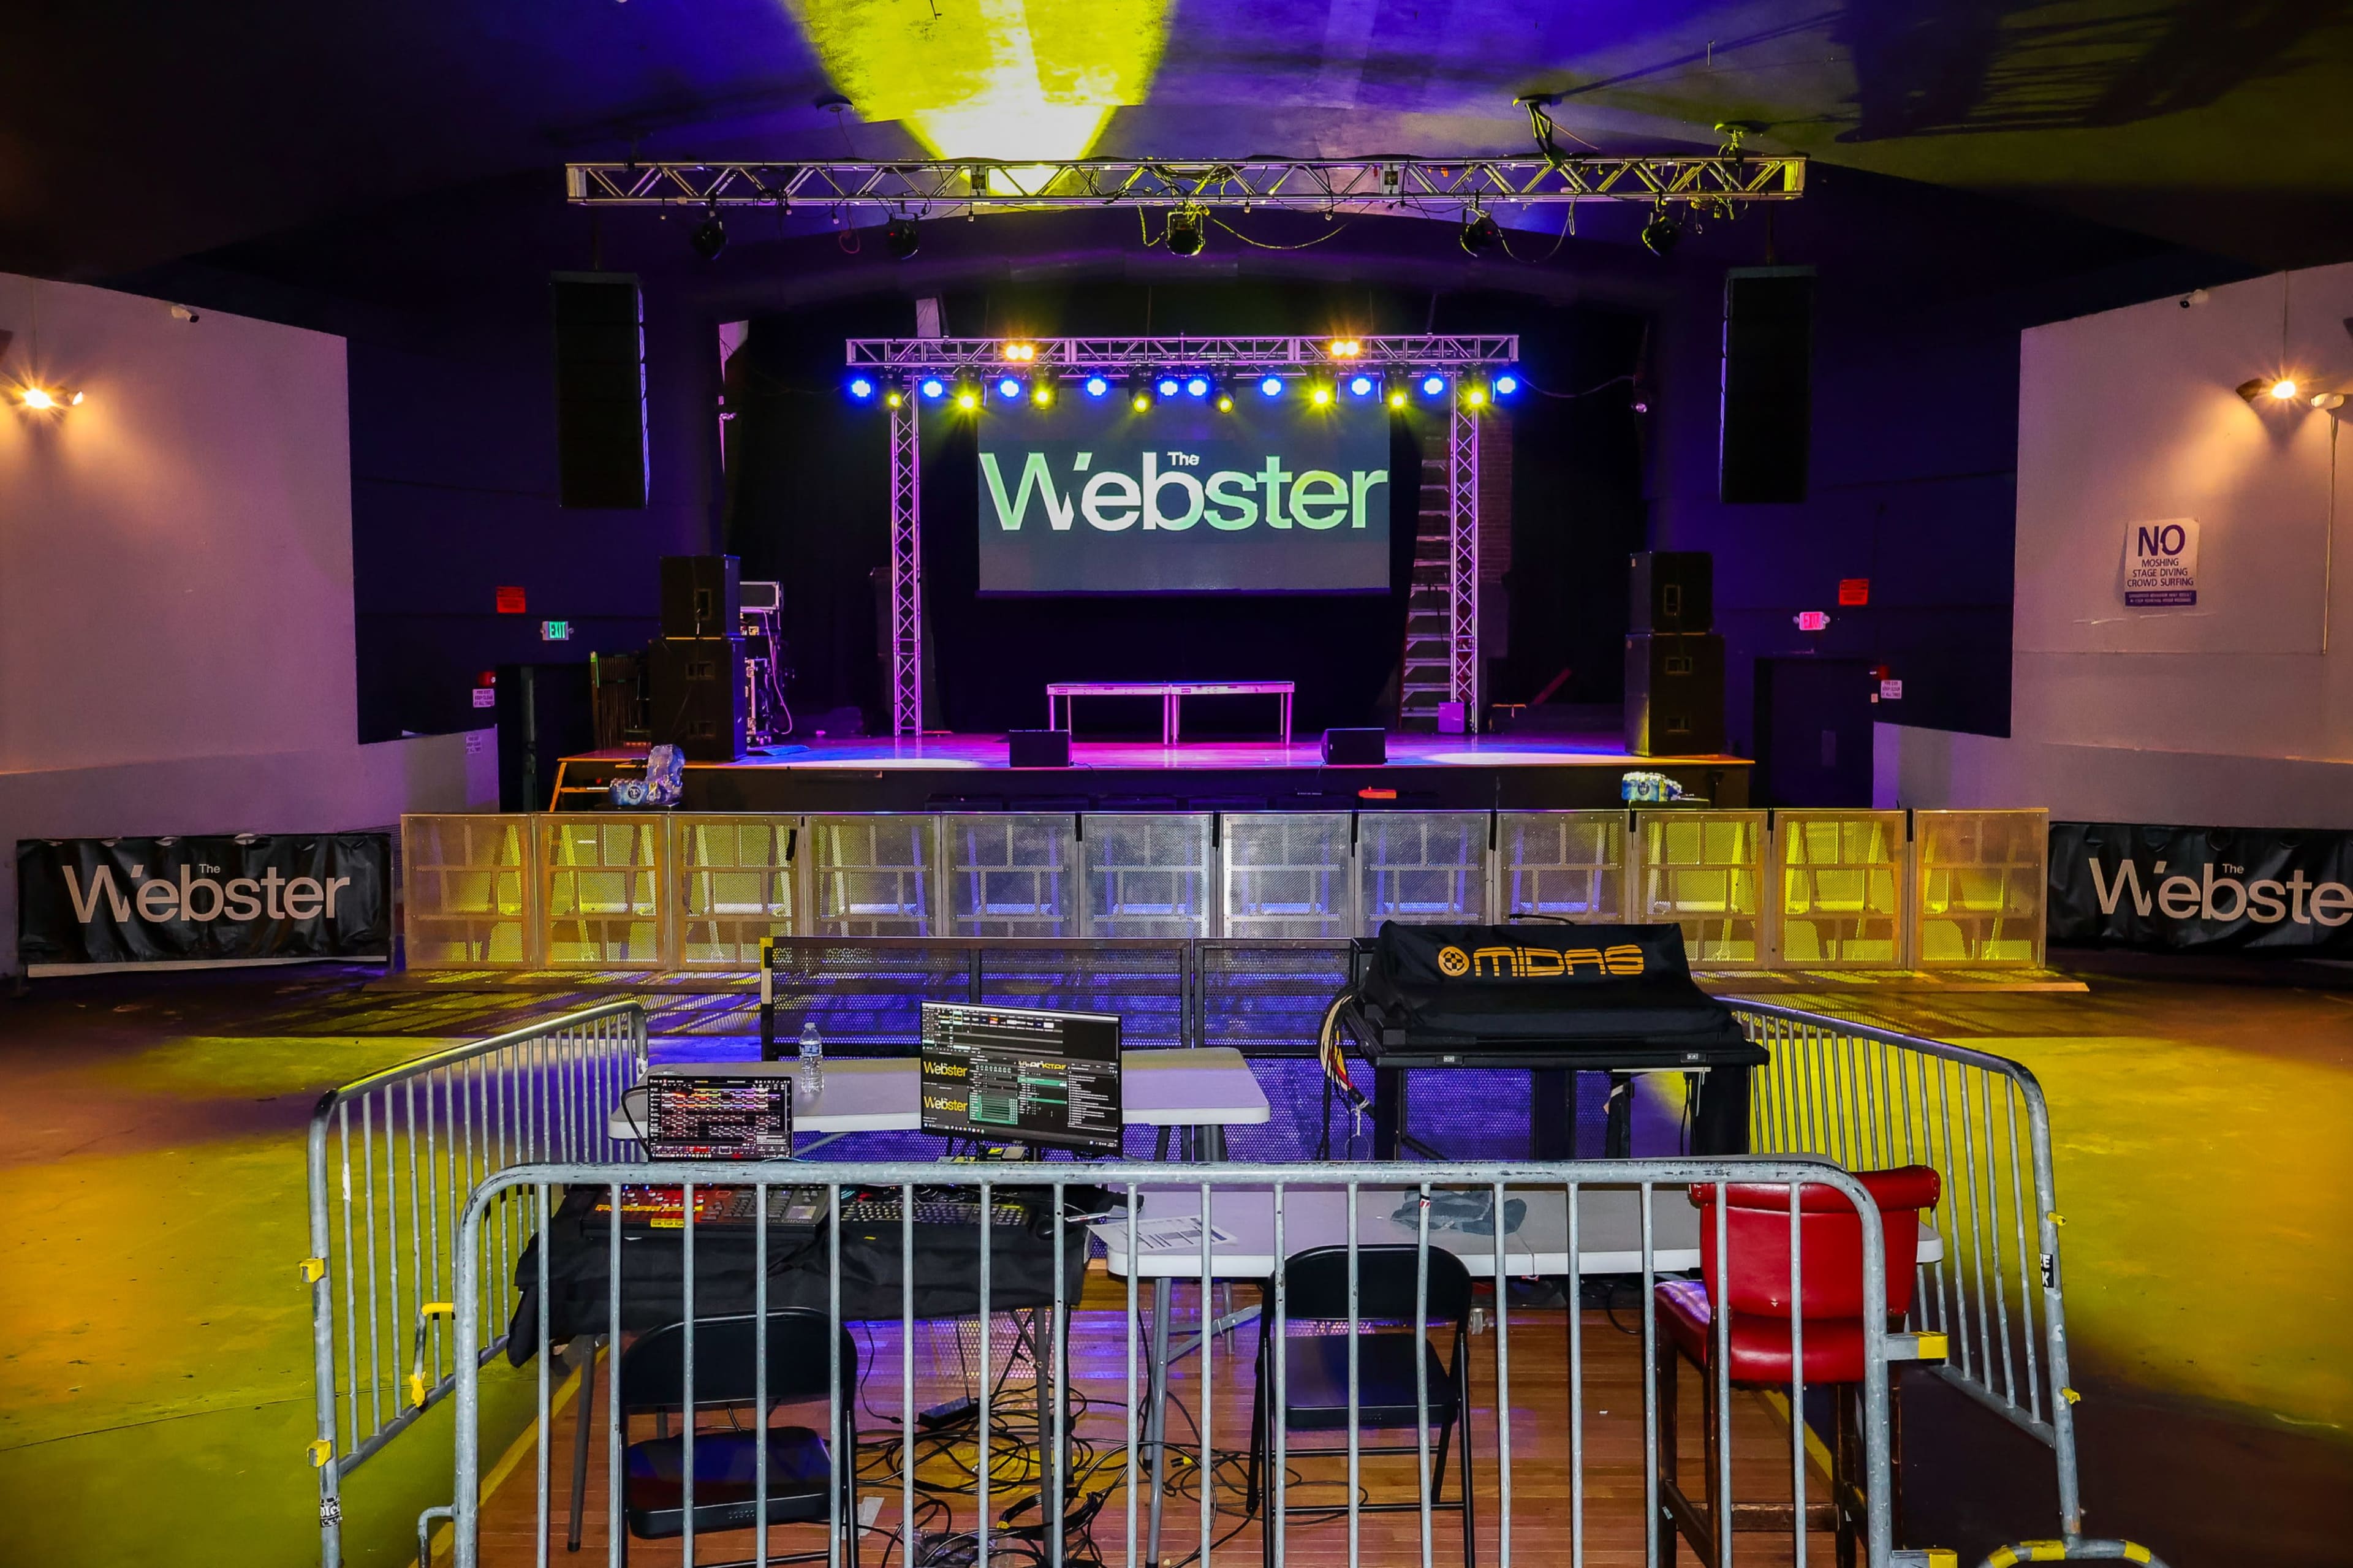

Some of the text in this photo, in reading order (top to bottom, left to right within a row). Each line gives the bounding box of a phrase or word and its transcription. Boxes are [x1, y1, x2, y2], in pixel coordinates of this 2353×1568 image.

[1167, 451, 1200, 466] The
[979, 451, 1389, 531] Webster
[2138, 524, 2186, 557] NO
[2142, 558, 2179, 567] MOSHING
[2132, 567, 2188, 578] STAGE DIVING
[2127, 577, 2194, 588] CROWD SURFING
[1803, 612, 1821, 629] EXIT
[548, 621, 566, 638] EXIT
[199, 863, 221, 874] The
[2222, 863, 2245, 875] The
[62, 863, 350, 923] Webster
[1473, 944, 1645, 977] MIDAS
[923, 1061, 968, 1077] Webster
[923, 1096, 968, 1112] Webster
